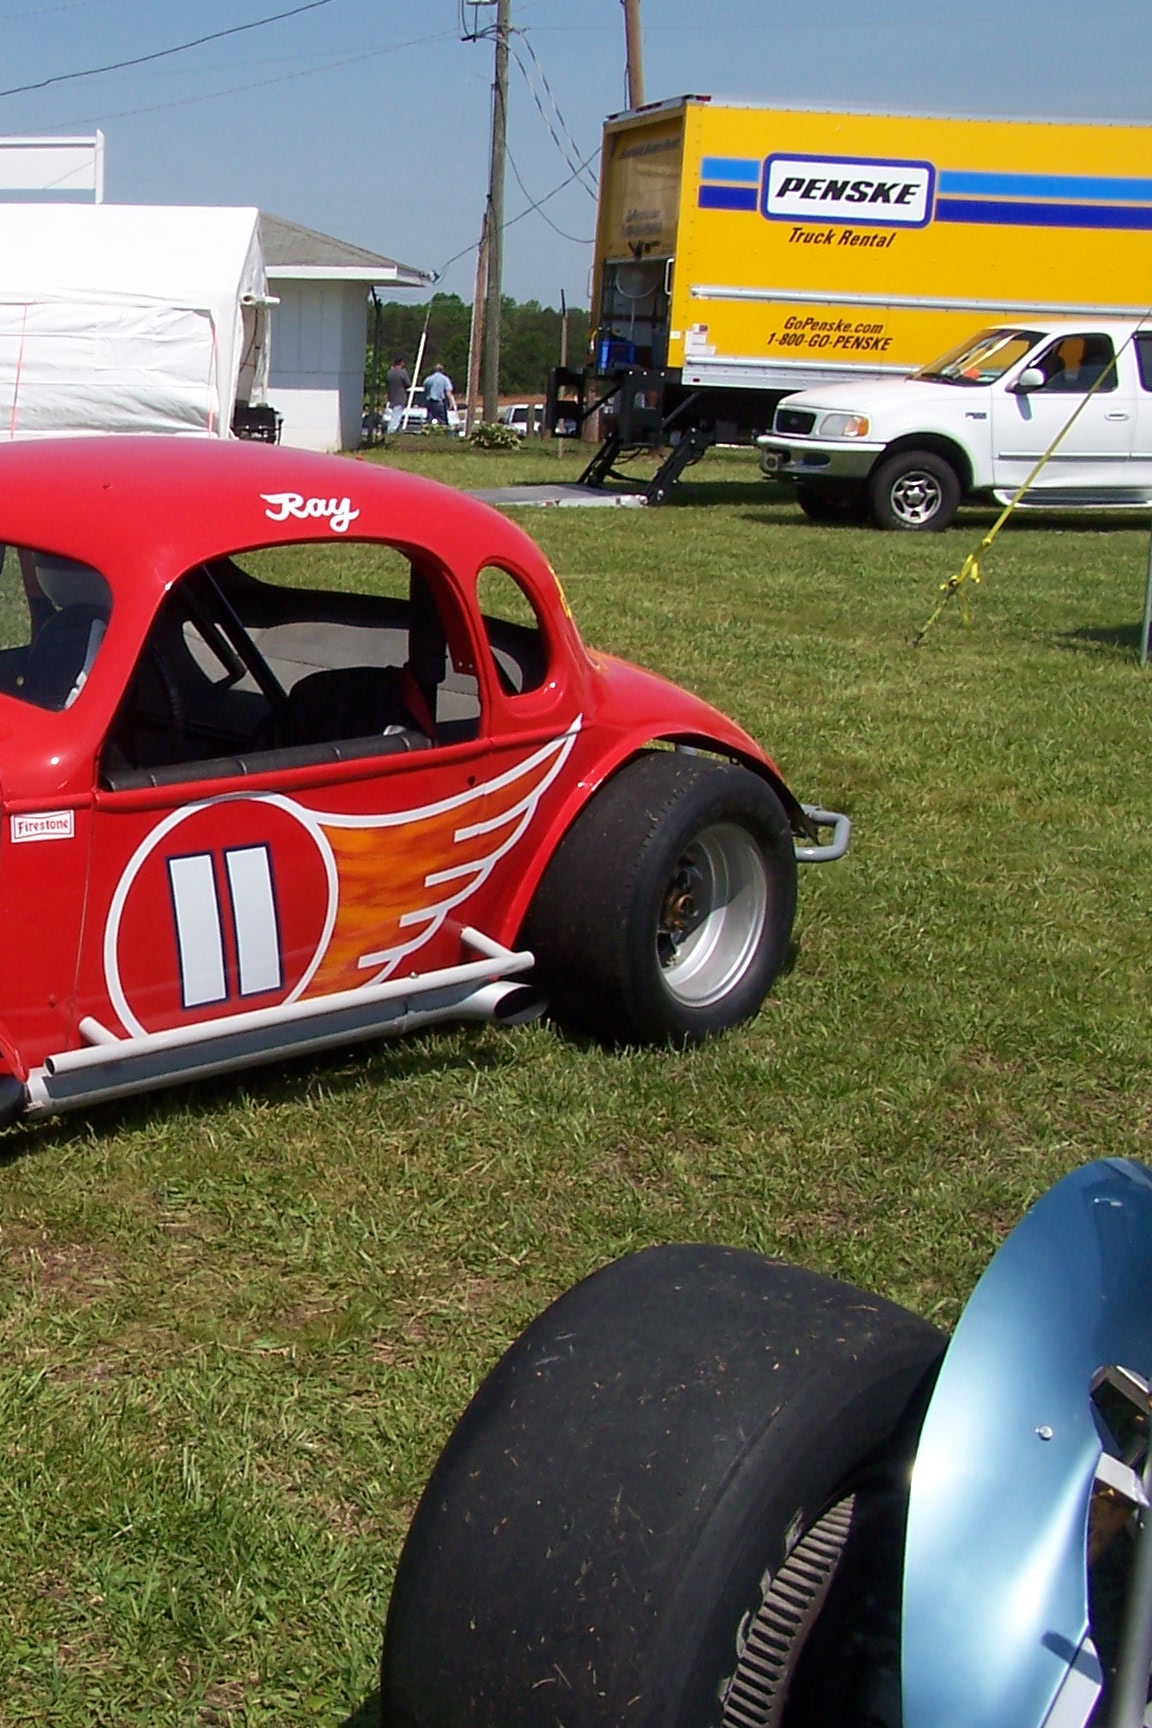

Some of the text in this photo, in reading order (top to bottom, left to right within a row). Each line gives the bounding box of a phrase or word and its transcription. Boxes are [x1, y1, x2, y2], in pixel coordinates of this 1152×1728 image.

[775, 176, 921, 205] PENSKE
[788, 227, 897, 248] Truck Rental
[783, 316, 884, 334] GoPenske.com
[767, 332, 893, 351] 1-800-GO-PENSKE
[260, 493, 360, 532] Ray
[17, 818, 69, 835] Firestone
[166, 844, 282, 1011] 11
